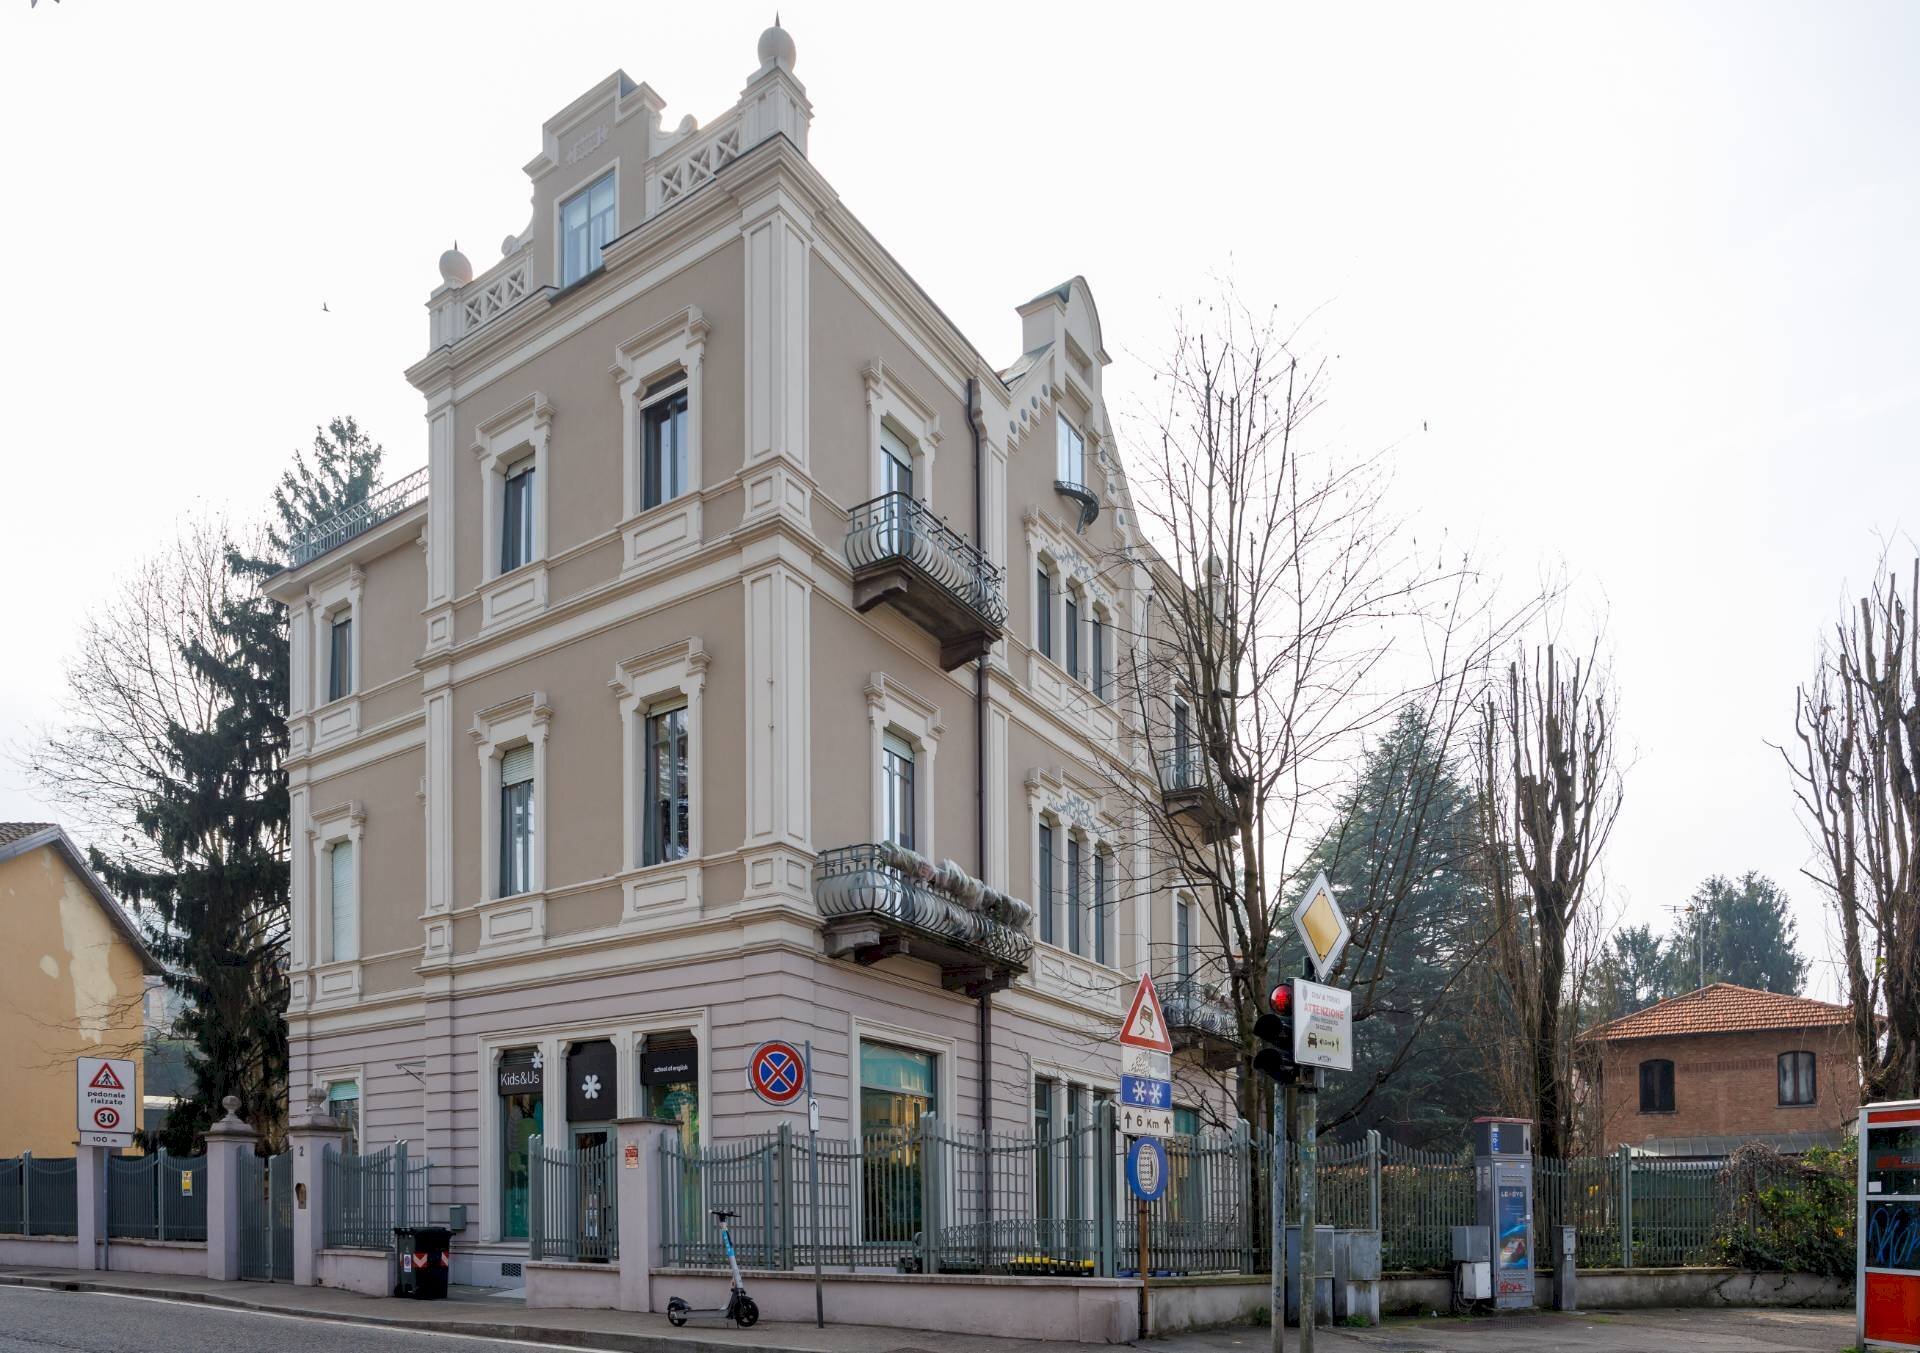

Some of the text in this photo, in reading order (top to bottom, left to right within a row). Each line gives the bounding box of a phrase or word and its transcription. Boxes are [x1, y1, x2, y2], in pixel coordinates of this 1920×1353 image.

[1304, 1002, 1344, 1020] ATTENZIONE
[500, 1071, 540, 1086] Kids&Us
[87, 1091, 126, 1099] pedonale
[90, 1098, 123, 1106] rialzato
[99, 1113, 115, 1123] 30
[1136, 1115, 1160, 1129] 6 Km
